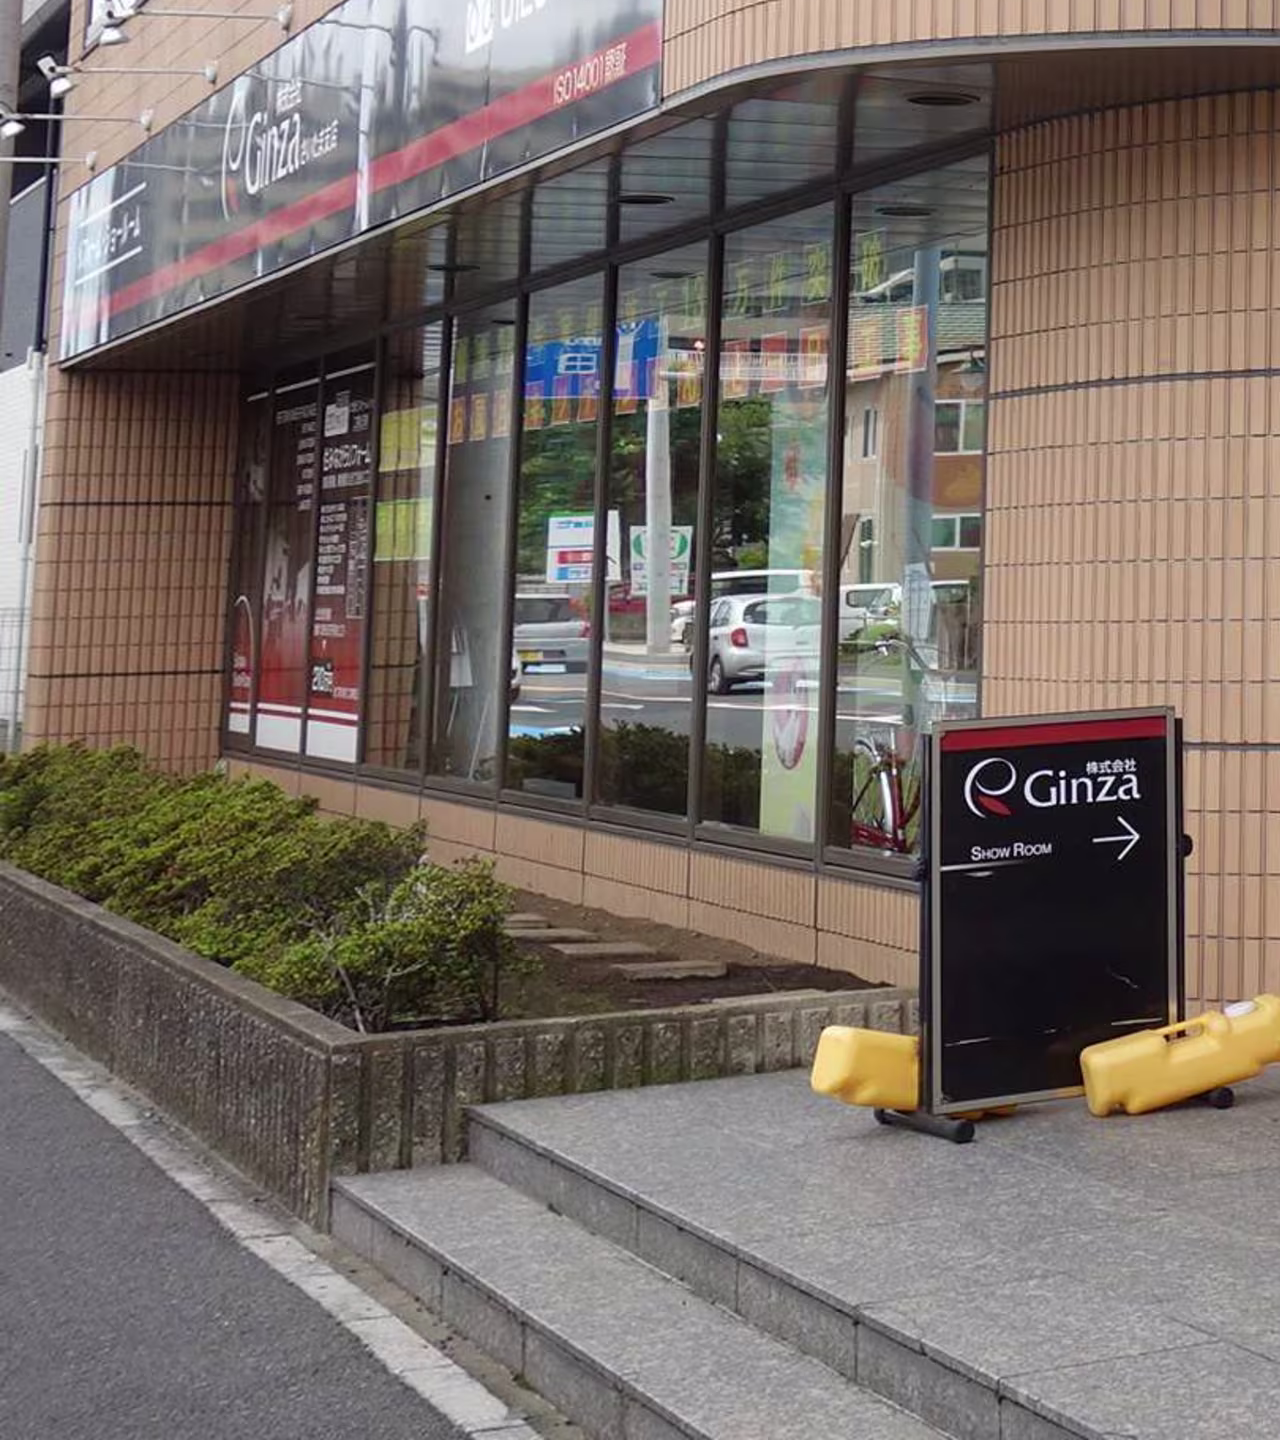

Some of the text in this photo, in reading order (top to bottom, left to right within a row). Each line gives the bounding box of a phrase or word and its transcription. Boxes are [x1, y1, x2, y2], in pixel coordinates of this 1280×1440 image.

[246, 112, 300, 195] Ginza
[1086, 758, 1137, 774] 株式会社
[1024, 771, 1141, 808] Ginza
